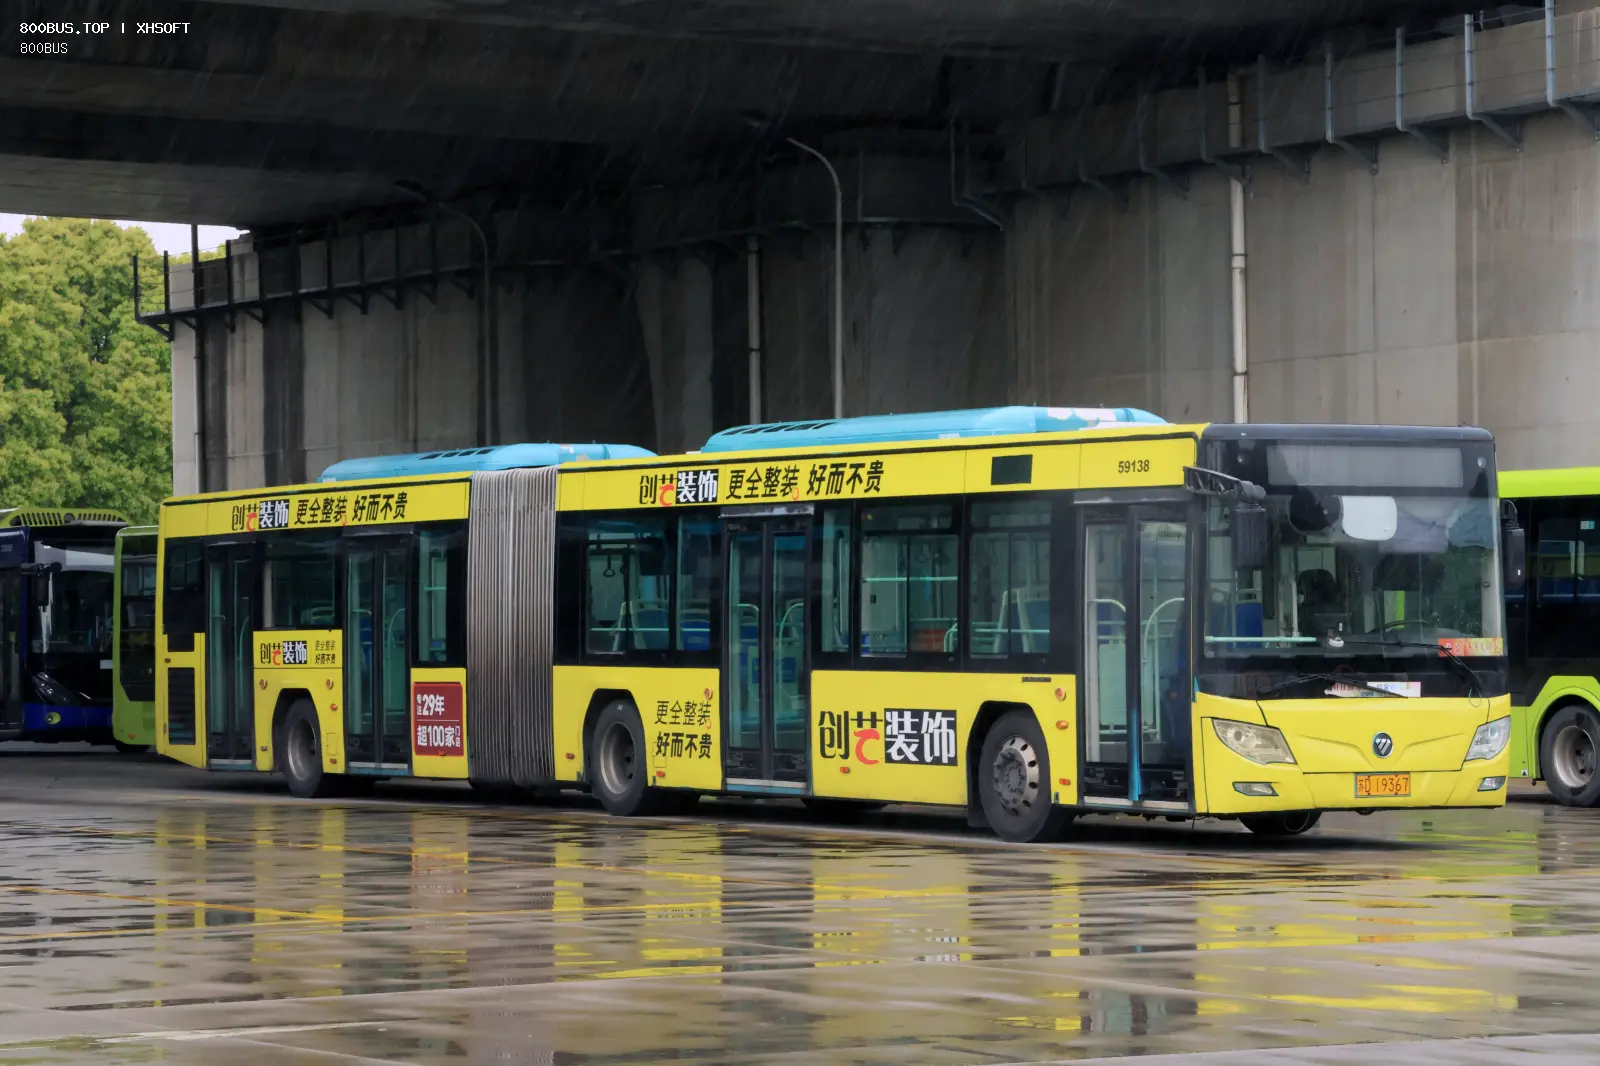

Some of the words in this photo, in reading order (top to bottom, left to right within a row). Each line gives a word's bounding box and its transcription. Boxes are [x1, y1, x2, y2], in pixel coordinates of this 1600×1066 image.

[1118, 459, 1150, 474] 59138
[639, 468, 719, 507] 创艺装饰
[725, 465, 800, 501] 更全整装
[806, 459, 884, 496] 好而不贵
[231, 499, 290, 532] 创艺装饰
[294, 496, 348, 526] 更全整装
[351, 491, 408, 522] 好而不贵
[260, 640, 308, 666] 创艺装饰
[654, 700, 712, 730] 更全整装
[655, 732, 713, 760] 好而不贵
[818, 707, 958, 766] 创艺装饰
